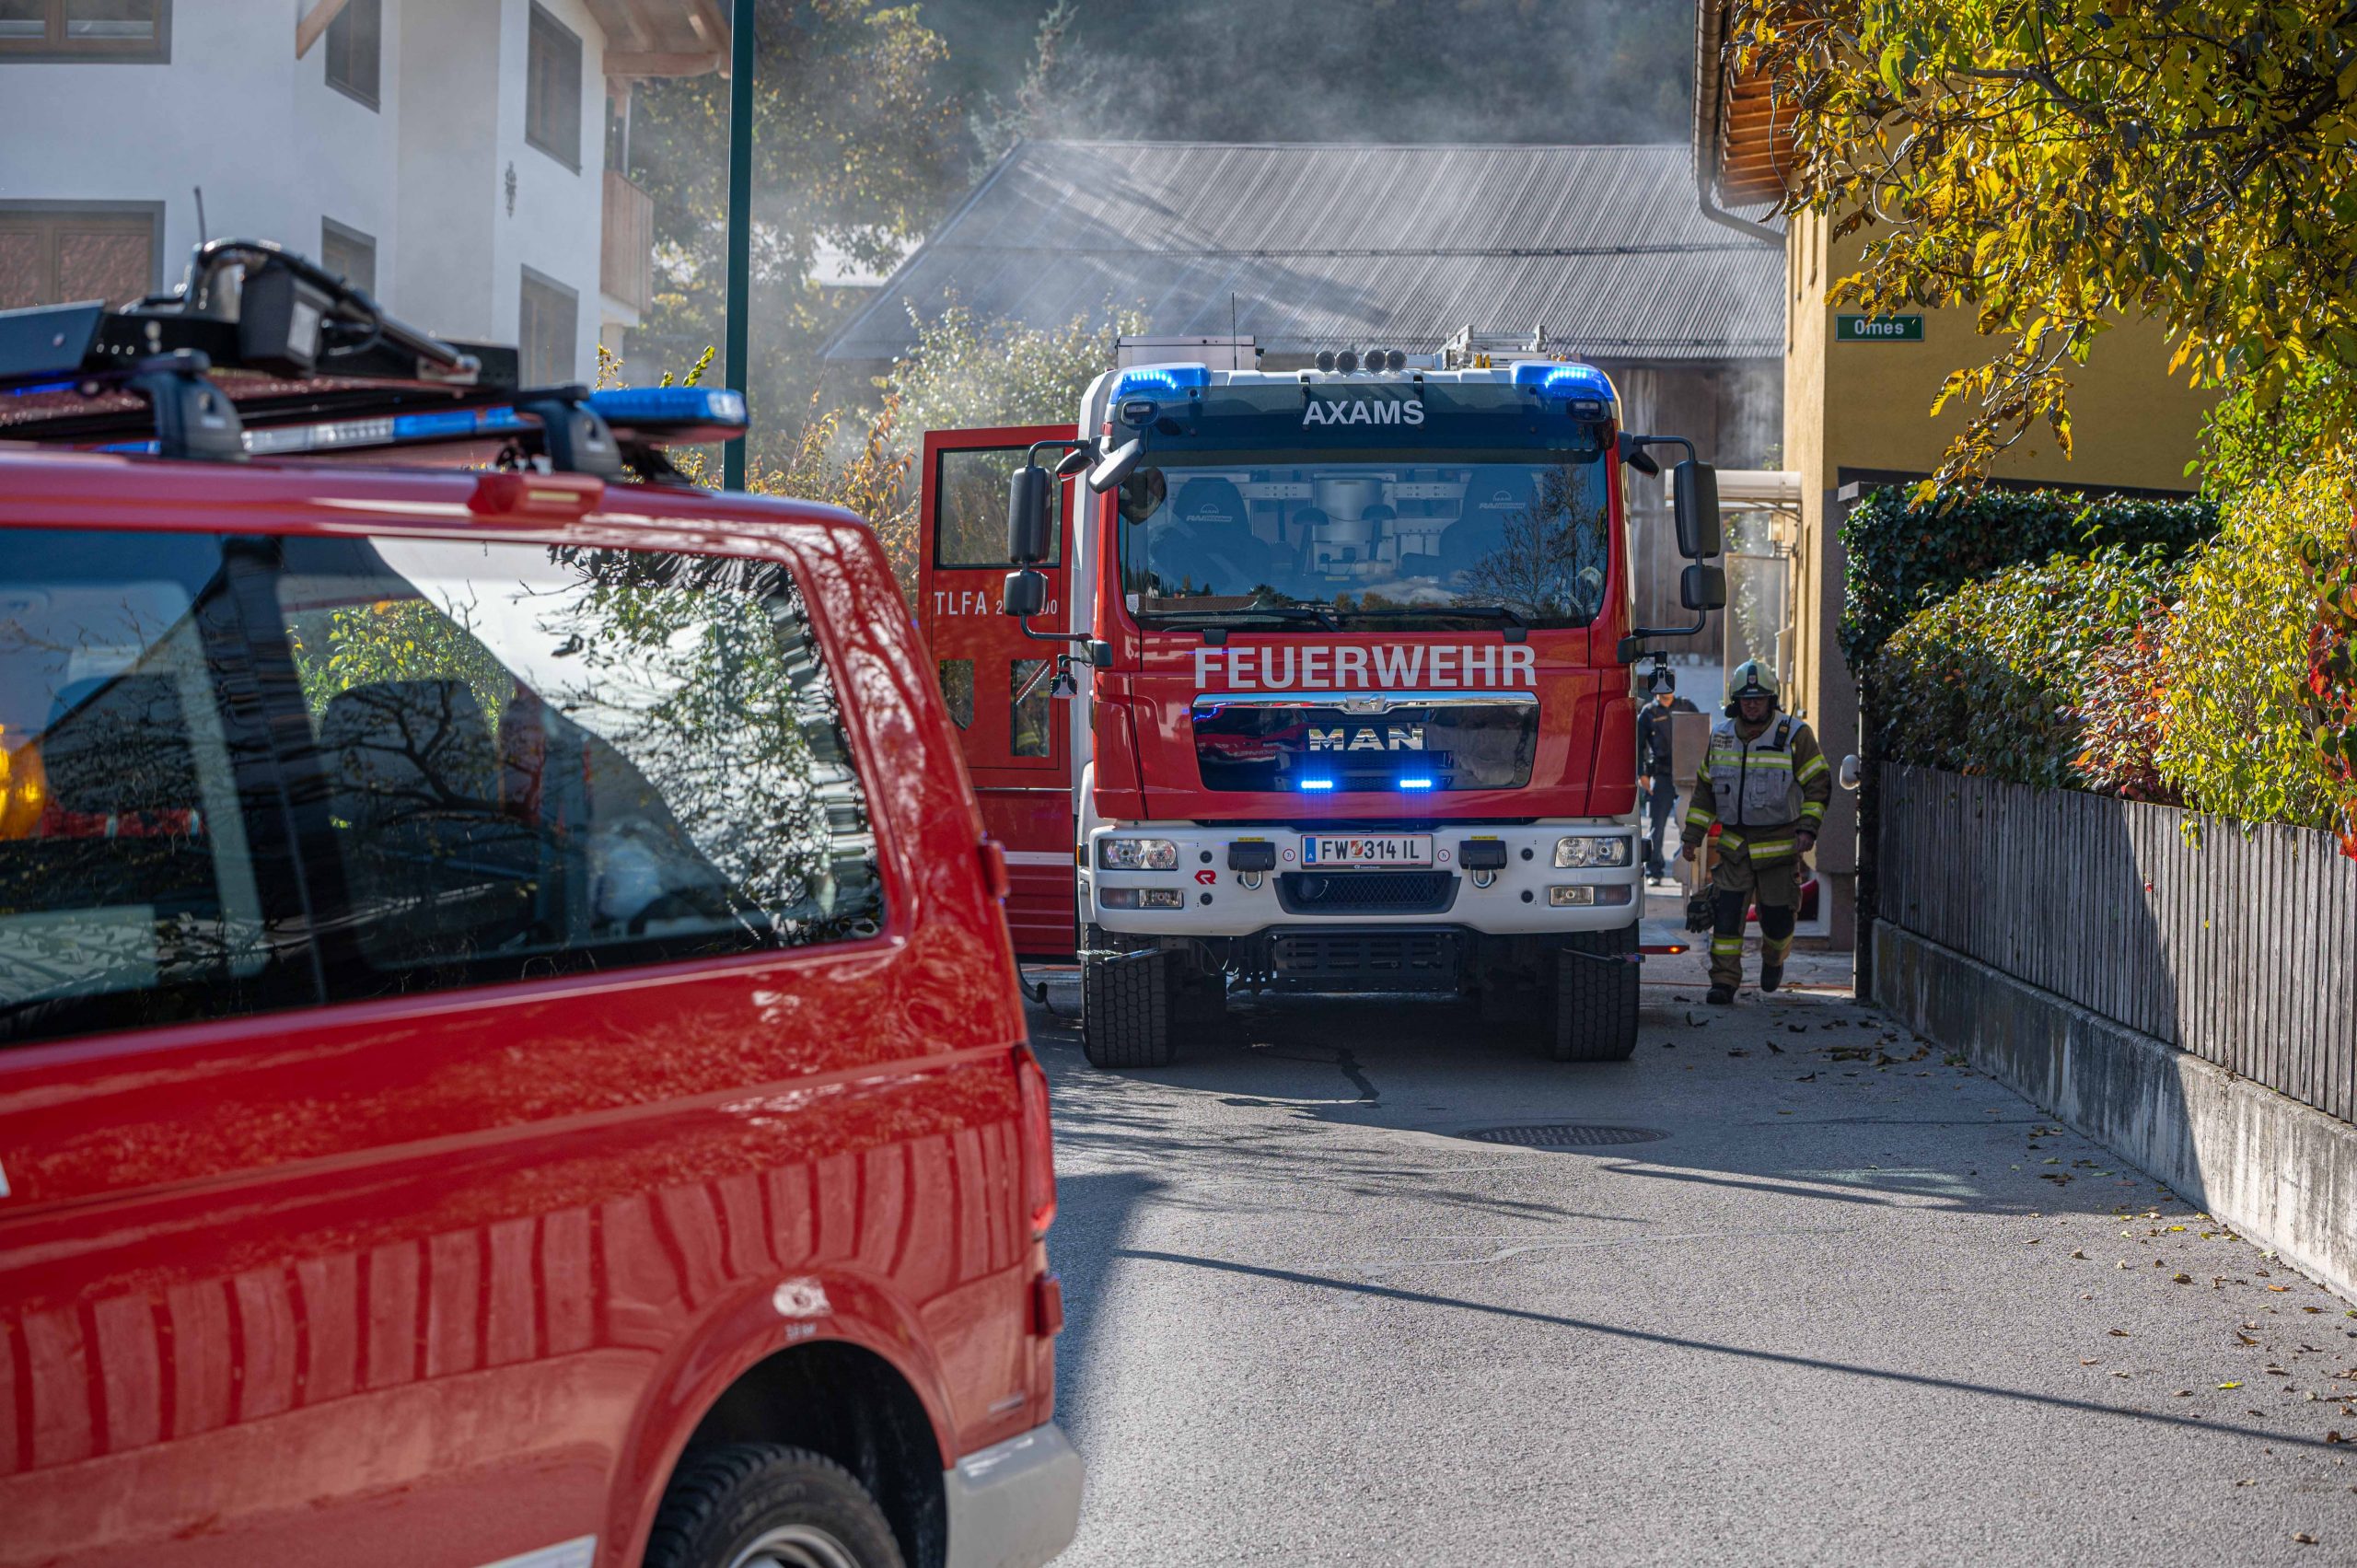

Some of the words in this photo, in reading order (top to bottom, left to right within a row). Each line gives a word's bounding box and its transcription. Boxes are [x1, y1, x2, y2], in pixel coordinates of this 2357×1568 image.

[1854, 319, 1904, 335] Omes
[1302, 400, 1424, 425] AXAMS
[934, 591, 988, 615] TLFA
[1194, 645, 1538, 689] FEUERWEHR
[1308, 727, 1423, 751] MAN
[1321, 840, 1349, 860] FW
[1364, 839, 1397, 860] 314
[1403, 840, 1420, 859] IL
